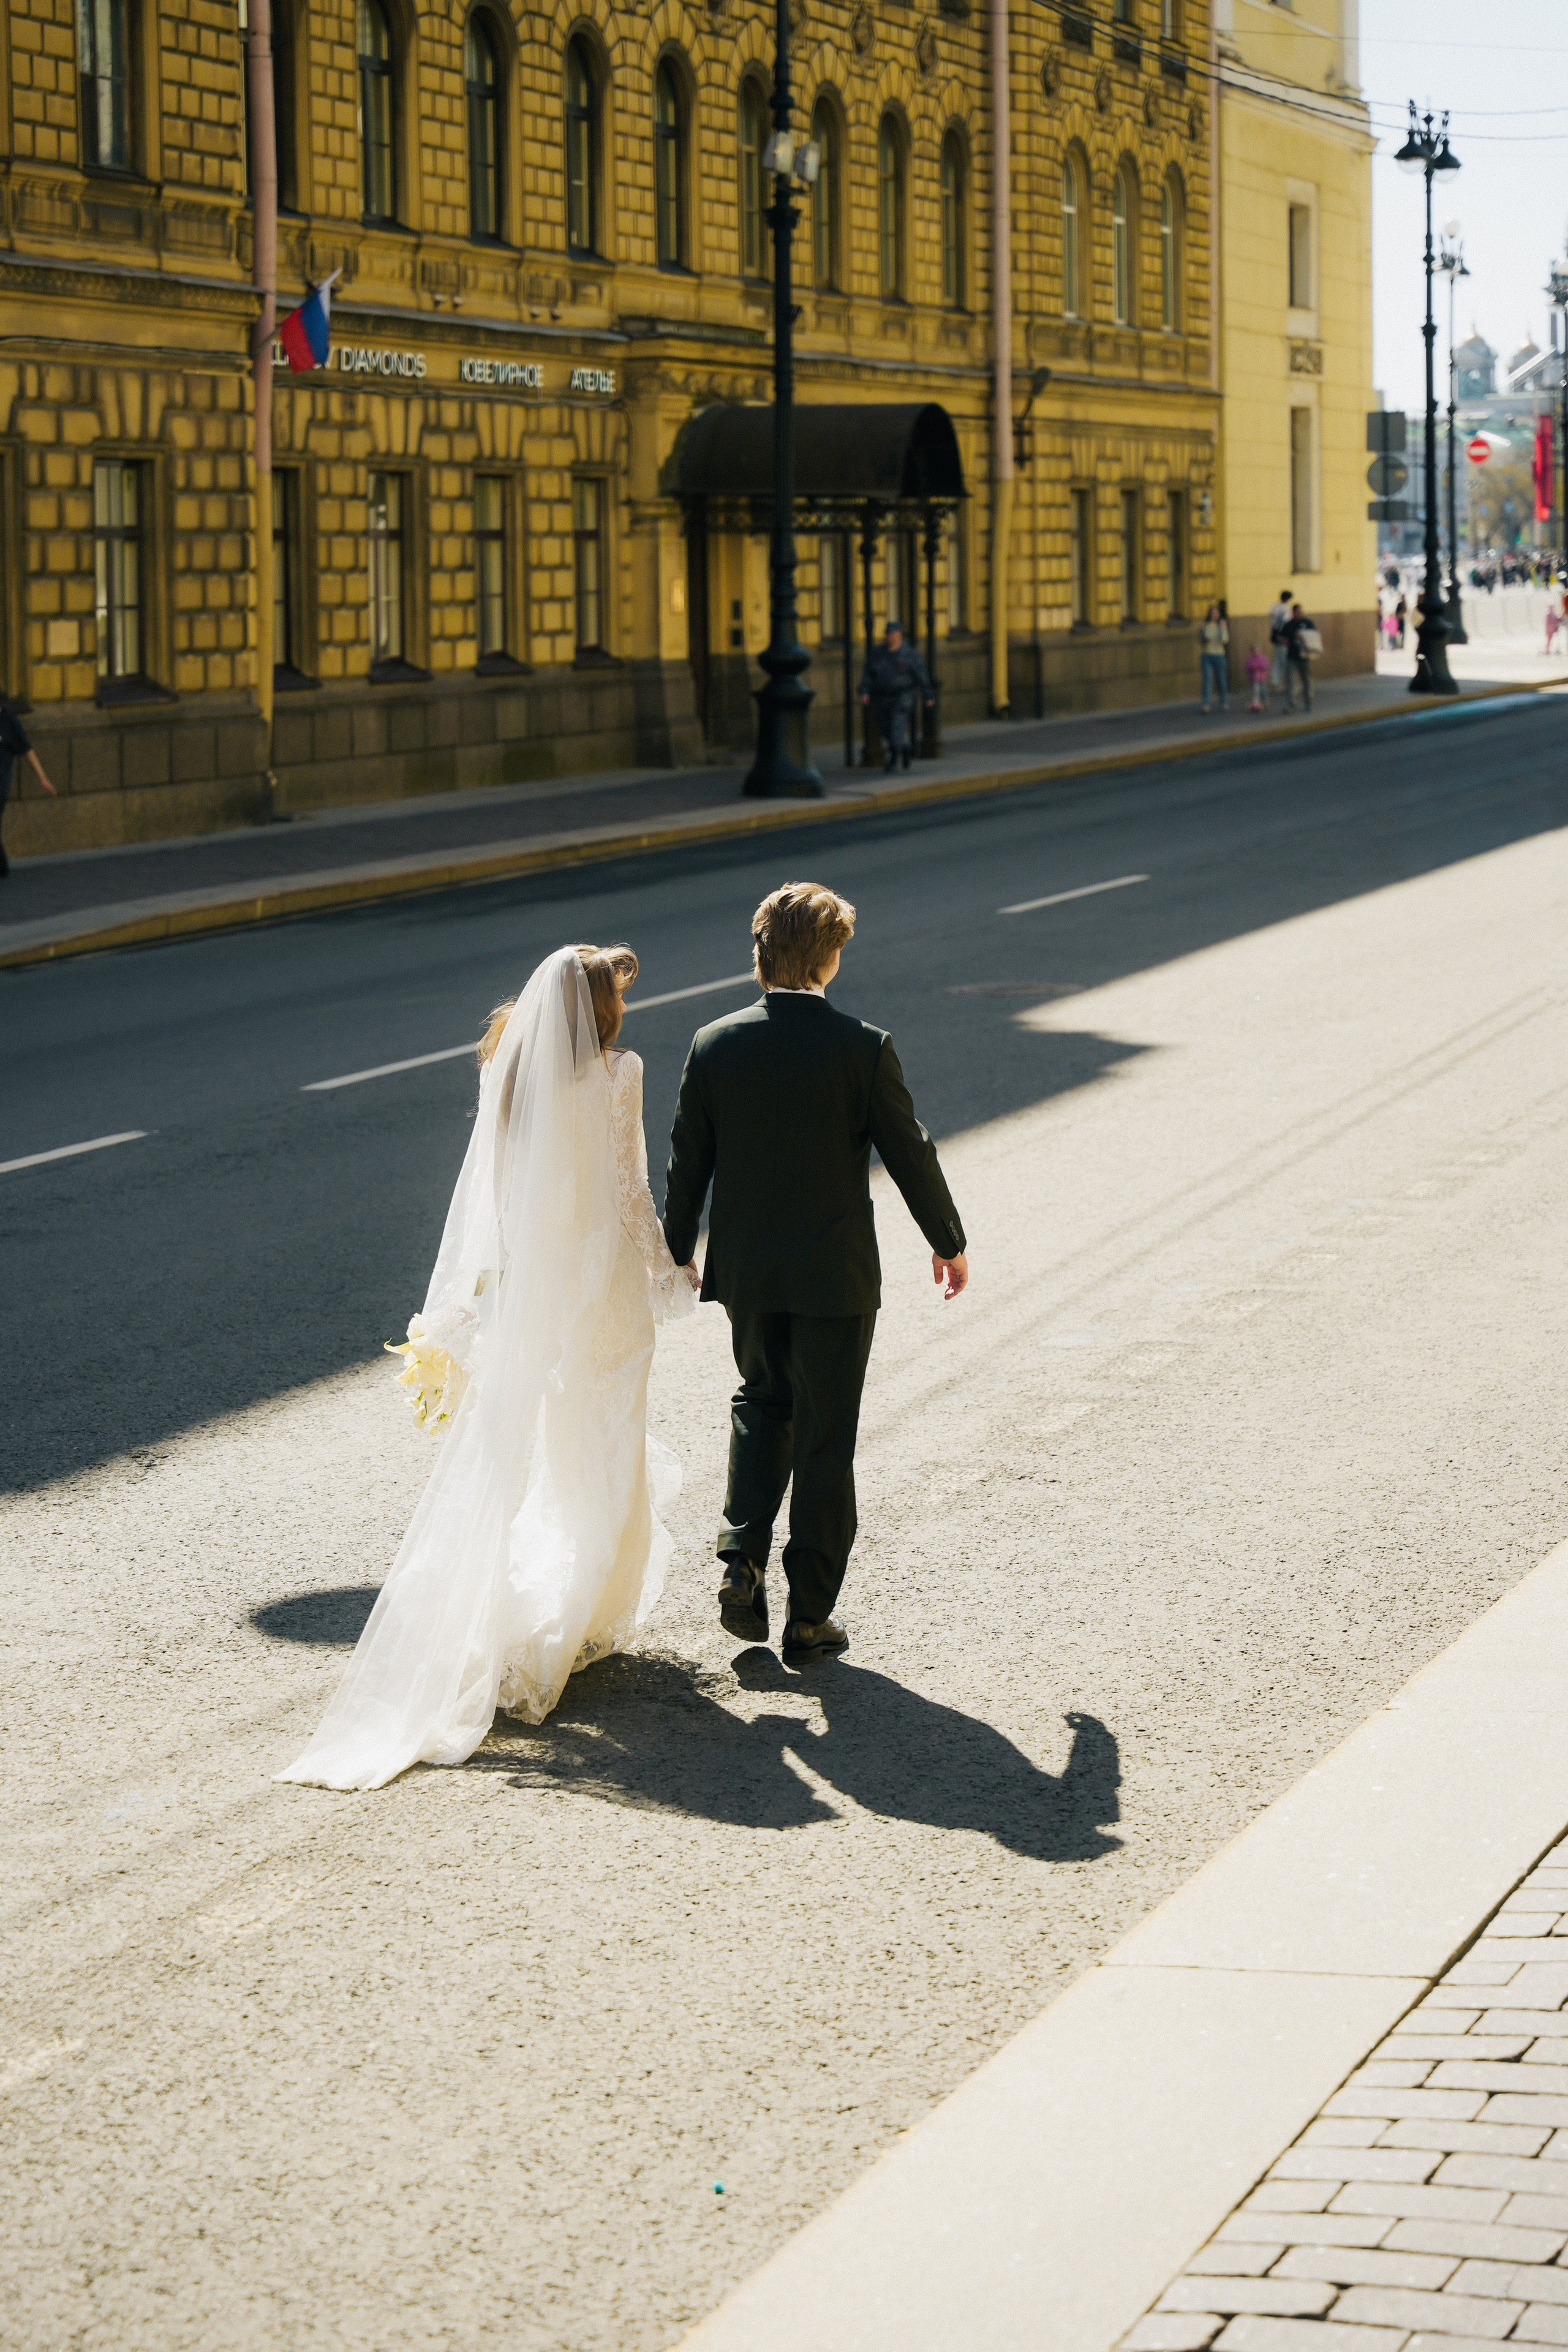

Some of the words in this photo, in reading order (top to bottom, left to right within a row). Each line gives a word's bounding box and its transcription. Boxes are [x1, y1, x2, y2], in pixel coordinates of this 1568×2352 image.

[341, 345, 427, 378] DIAMONDS
[460, 357, 544, 388] ЮВЕЛИРНОЕ
[570, 368, 616, 393] АТЕЛЬЕ
